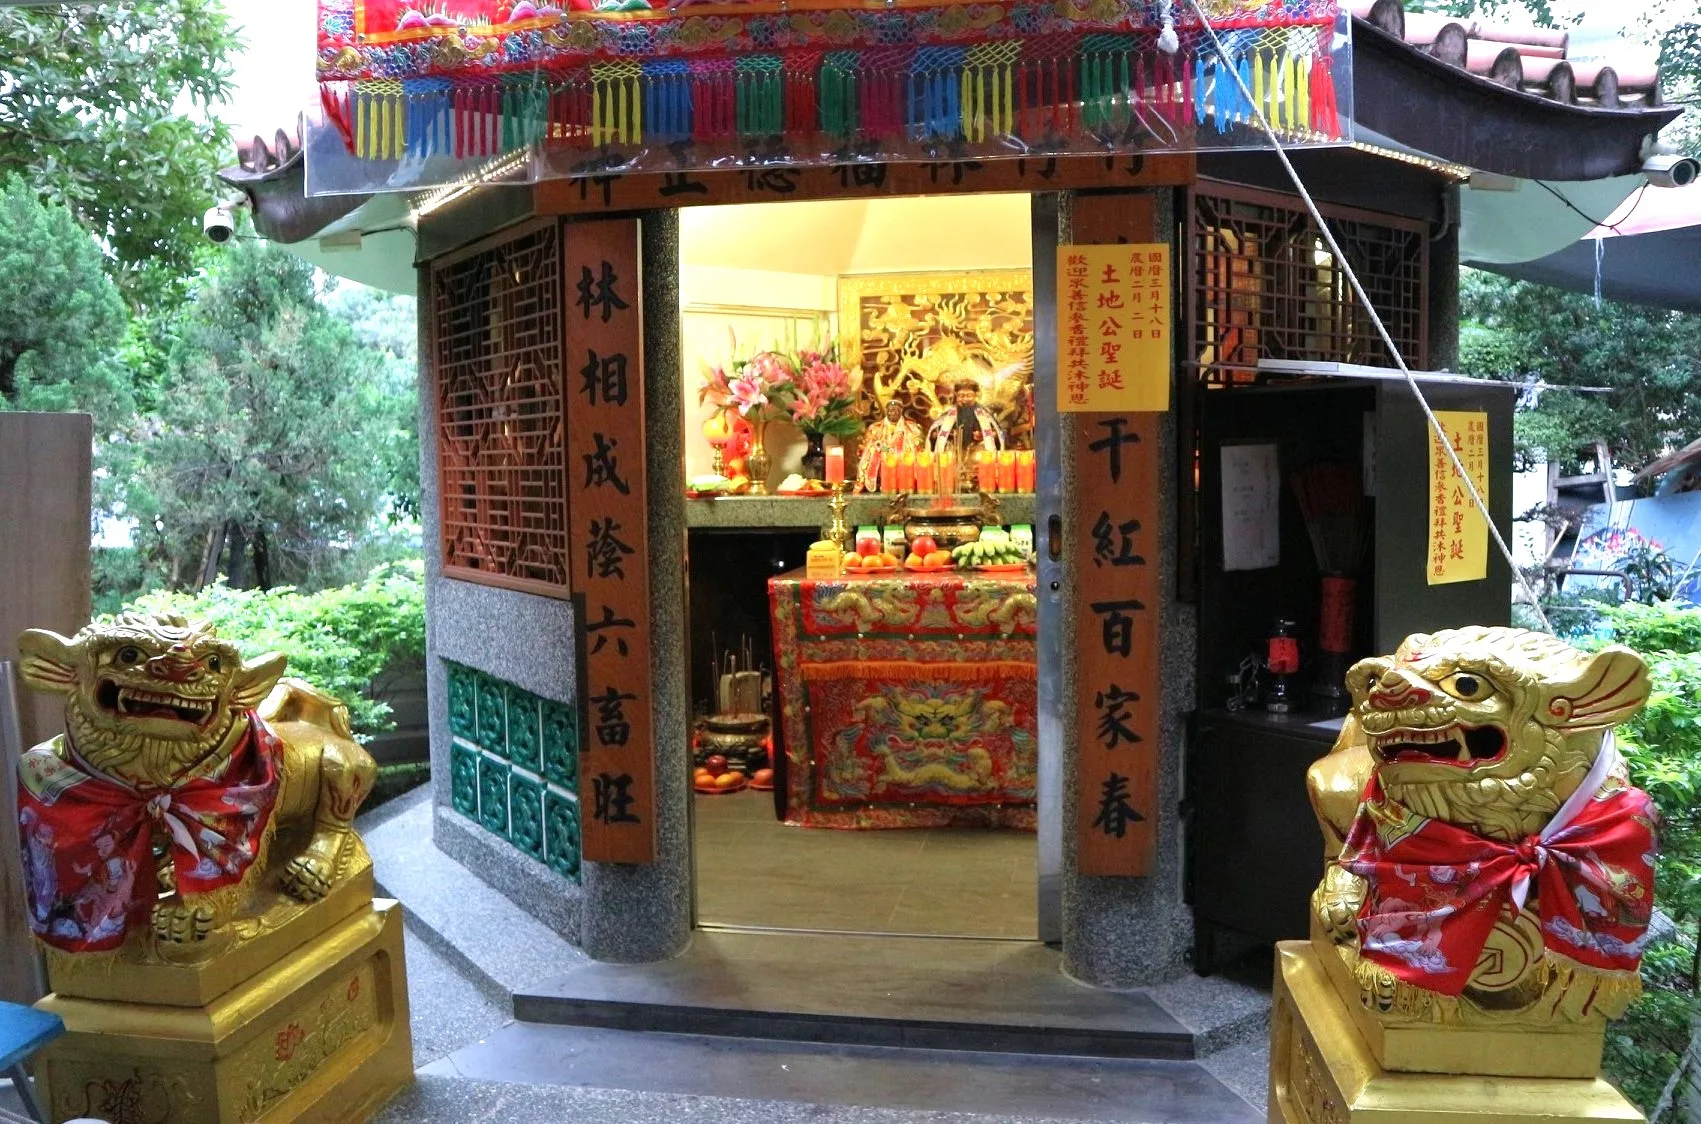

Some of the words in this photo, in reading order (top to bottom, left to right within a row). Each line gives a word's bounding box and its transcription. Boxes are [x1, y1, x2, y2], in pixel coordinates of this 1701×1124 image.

[1098, 264, 1124, 389] 土地公聖誕
[1467, 421, 1477, 508] 農曆二月日
[575, 259, 641, 826] 林相成蔭六畜旺
[1088, 236, 1147, 838] 千紅百家春
